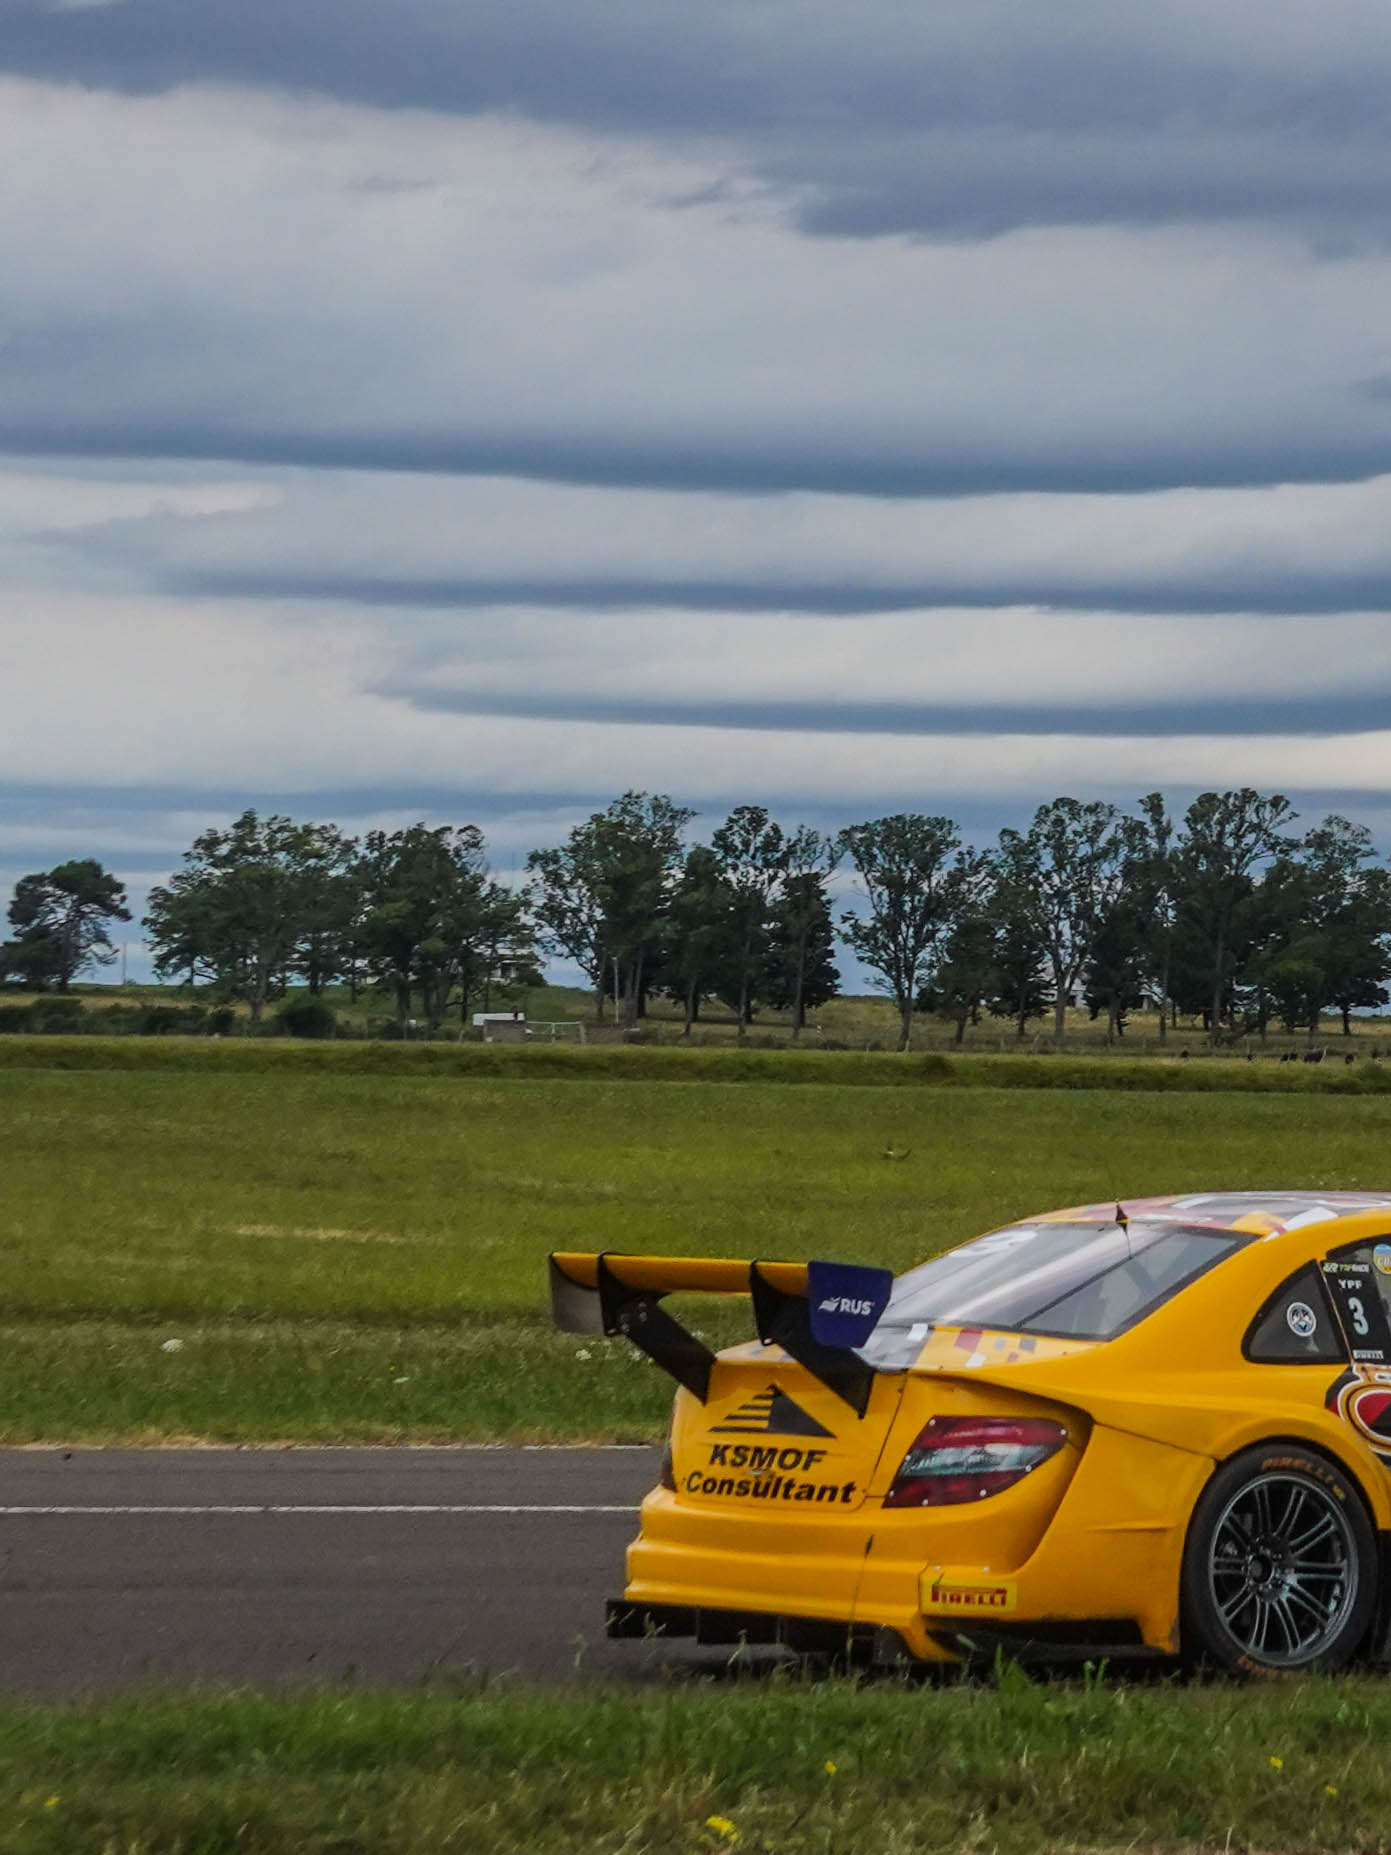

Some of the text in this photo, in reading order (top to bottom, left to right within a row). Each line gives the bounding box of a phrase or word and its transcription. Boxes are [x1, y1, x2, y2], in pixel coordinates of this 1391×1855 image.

[1338, 1280, 1362, 1290] YPF
[840, 1298, 872, 1315] RUS
[1348, 1297, 1369, 1335] 3
[709, 1444, 827, 1471] KSMOF
[686, 1471, 856, 1503] Consultant
[931, 1584, 1007, 1606] PIRELLI
